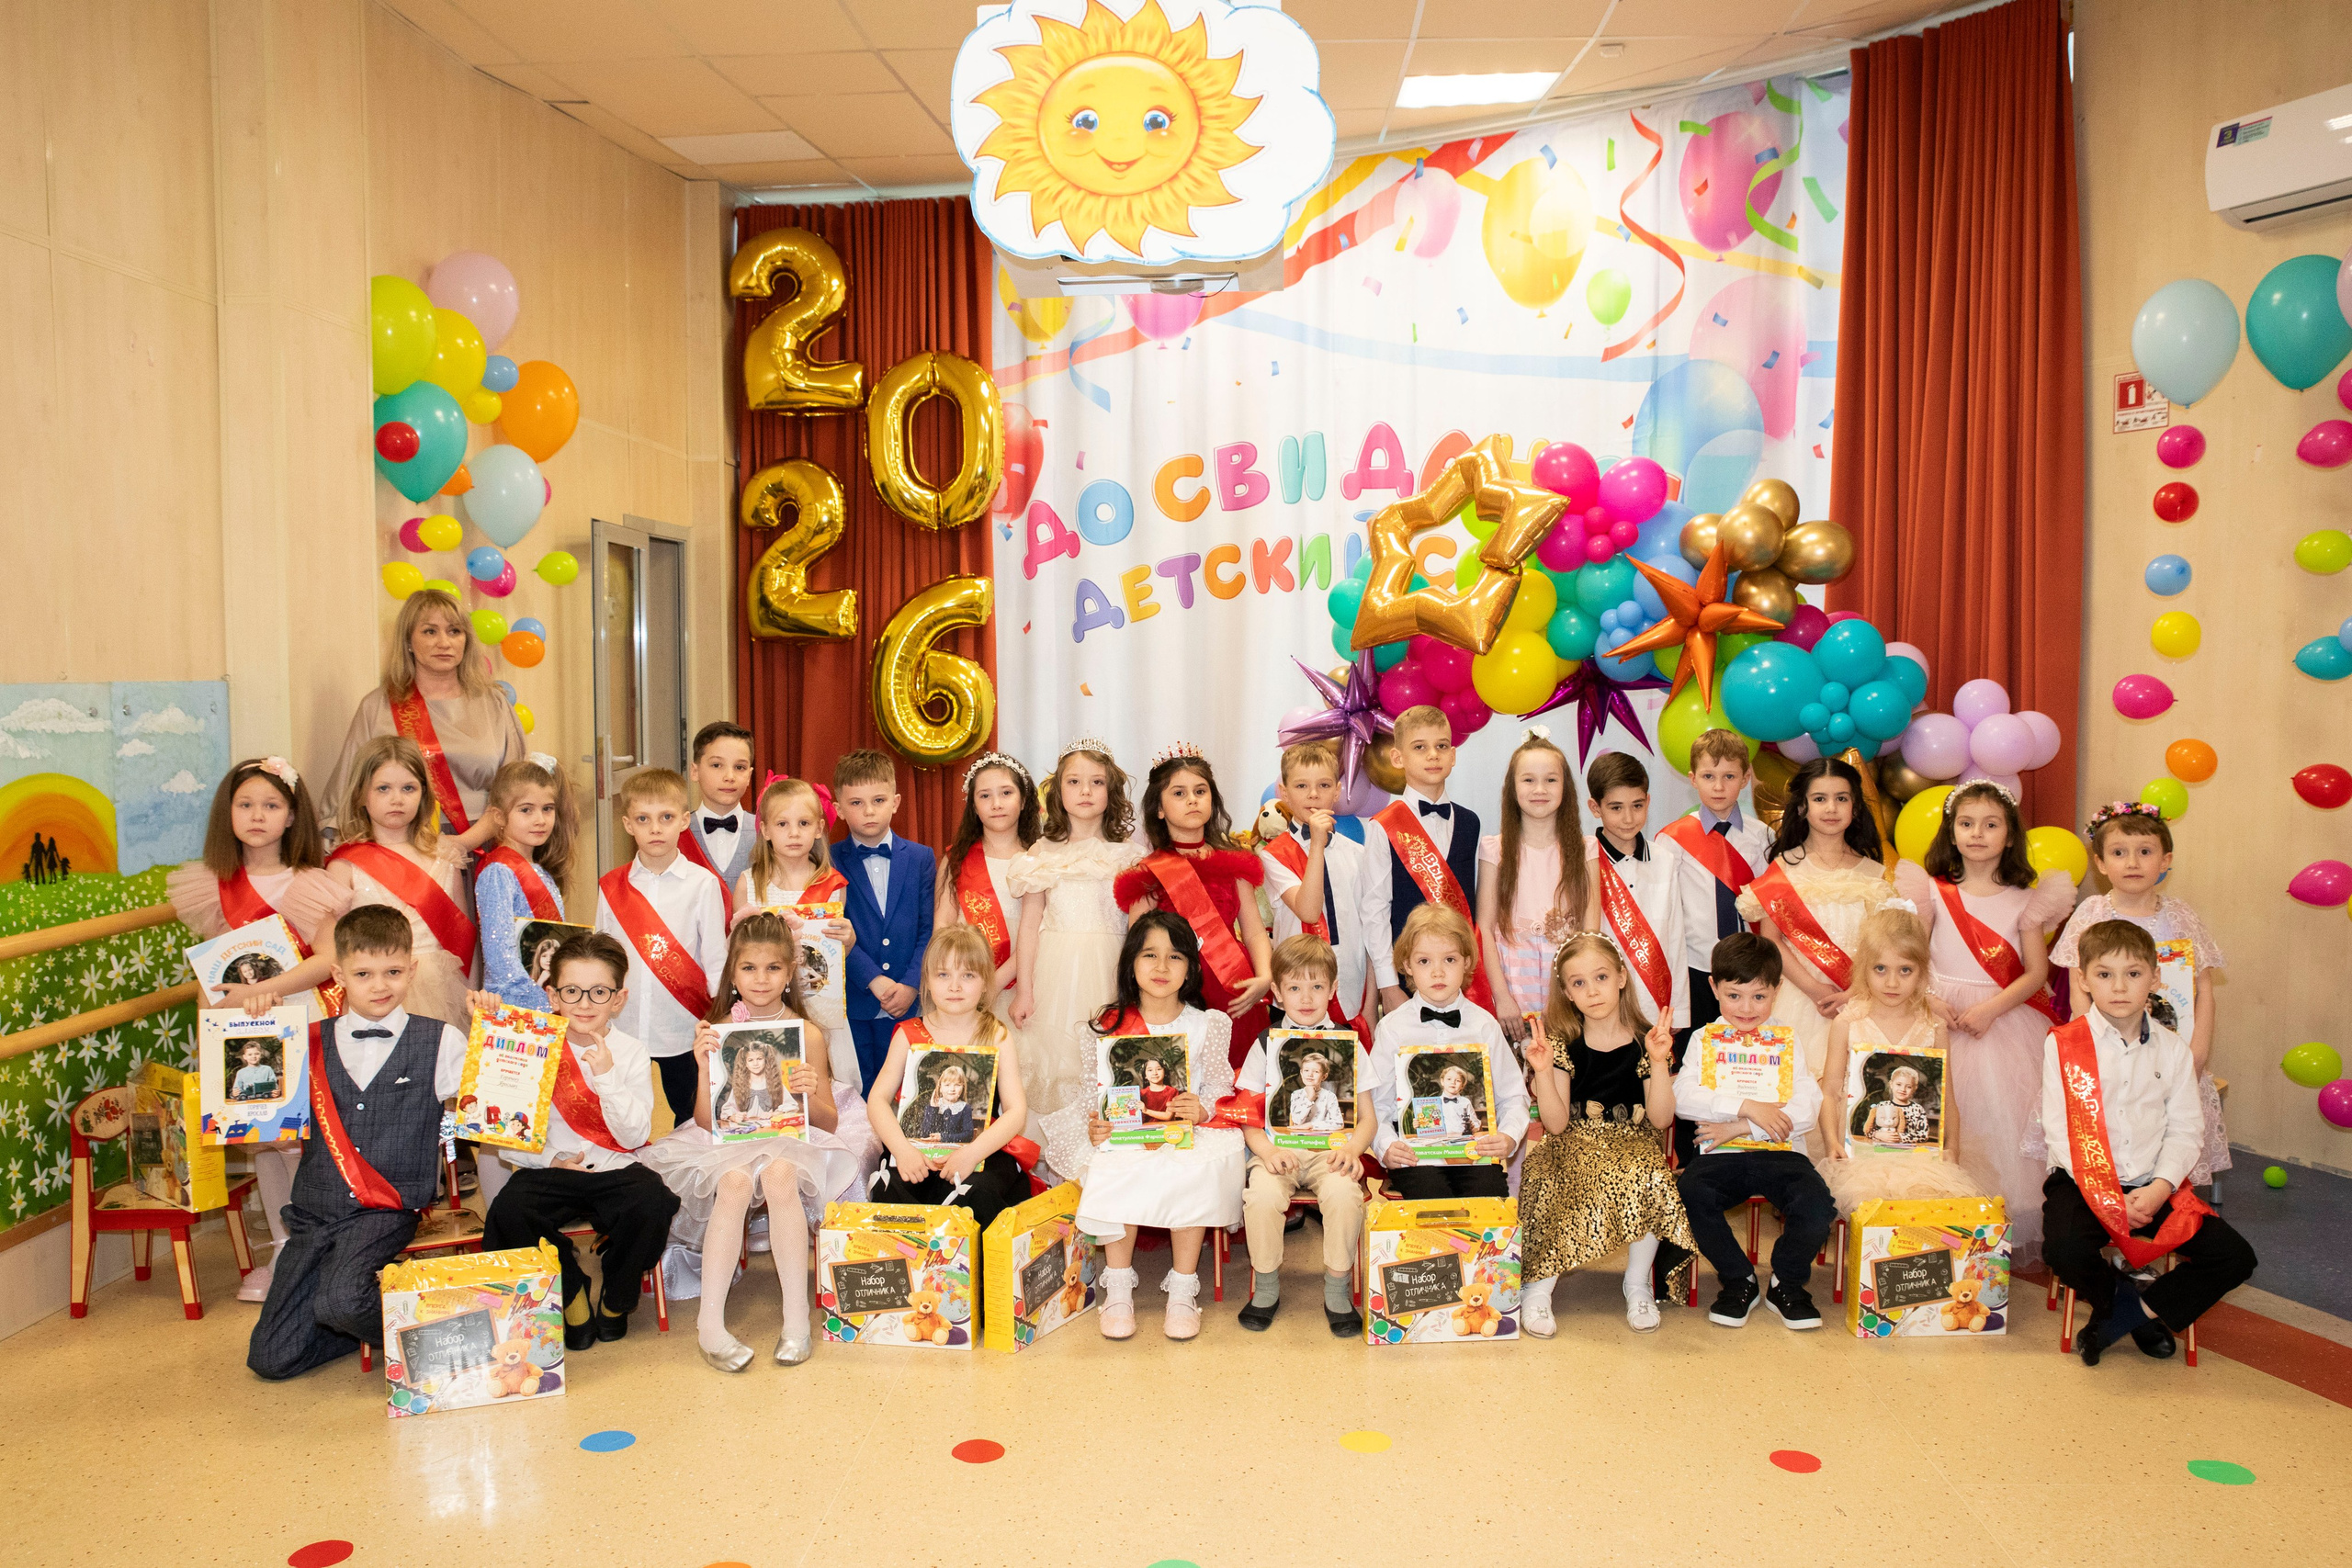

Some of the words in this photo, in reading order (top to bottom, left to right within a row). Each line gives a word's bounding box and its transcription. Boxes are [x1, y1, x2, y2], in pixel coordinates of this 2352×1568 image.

[1022, 479, 1134, 581] ДО
[208, 960, 222, 984] НАШ
[220, 940, 264, 962] ДЕТСКИЙ
[265, 941, 287, 956] САД
[229, 1020, 276, 1028] ВЫПУСКНОЙ
[483, 1034, 549, 1058] ДИПЛОМ
[1715, 1052, 1781, 1066] ДИПЛОМ
[860, 1274, 885, 1287] Набор
[1411, 1271, 1436, 1285] Набор
[1902, 1268, 1928, 1280] Набор
[855, 1286, 896, 1298] ОТЛИЧНИКА
[1895, 1278, 1938, 1292] ОТЛИЧНИКА
[435, 1332, 465, 1348] Набор
